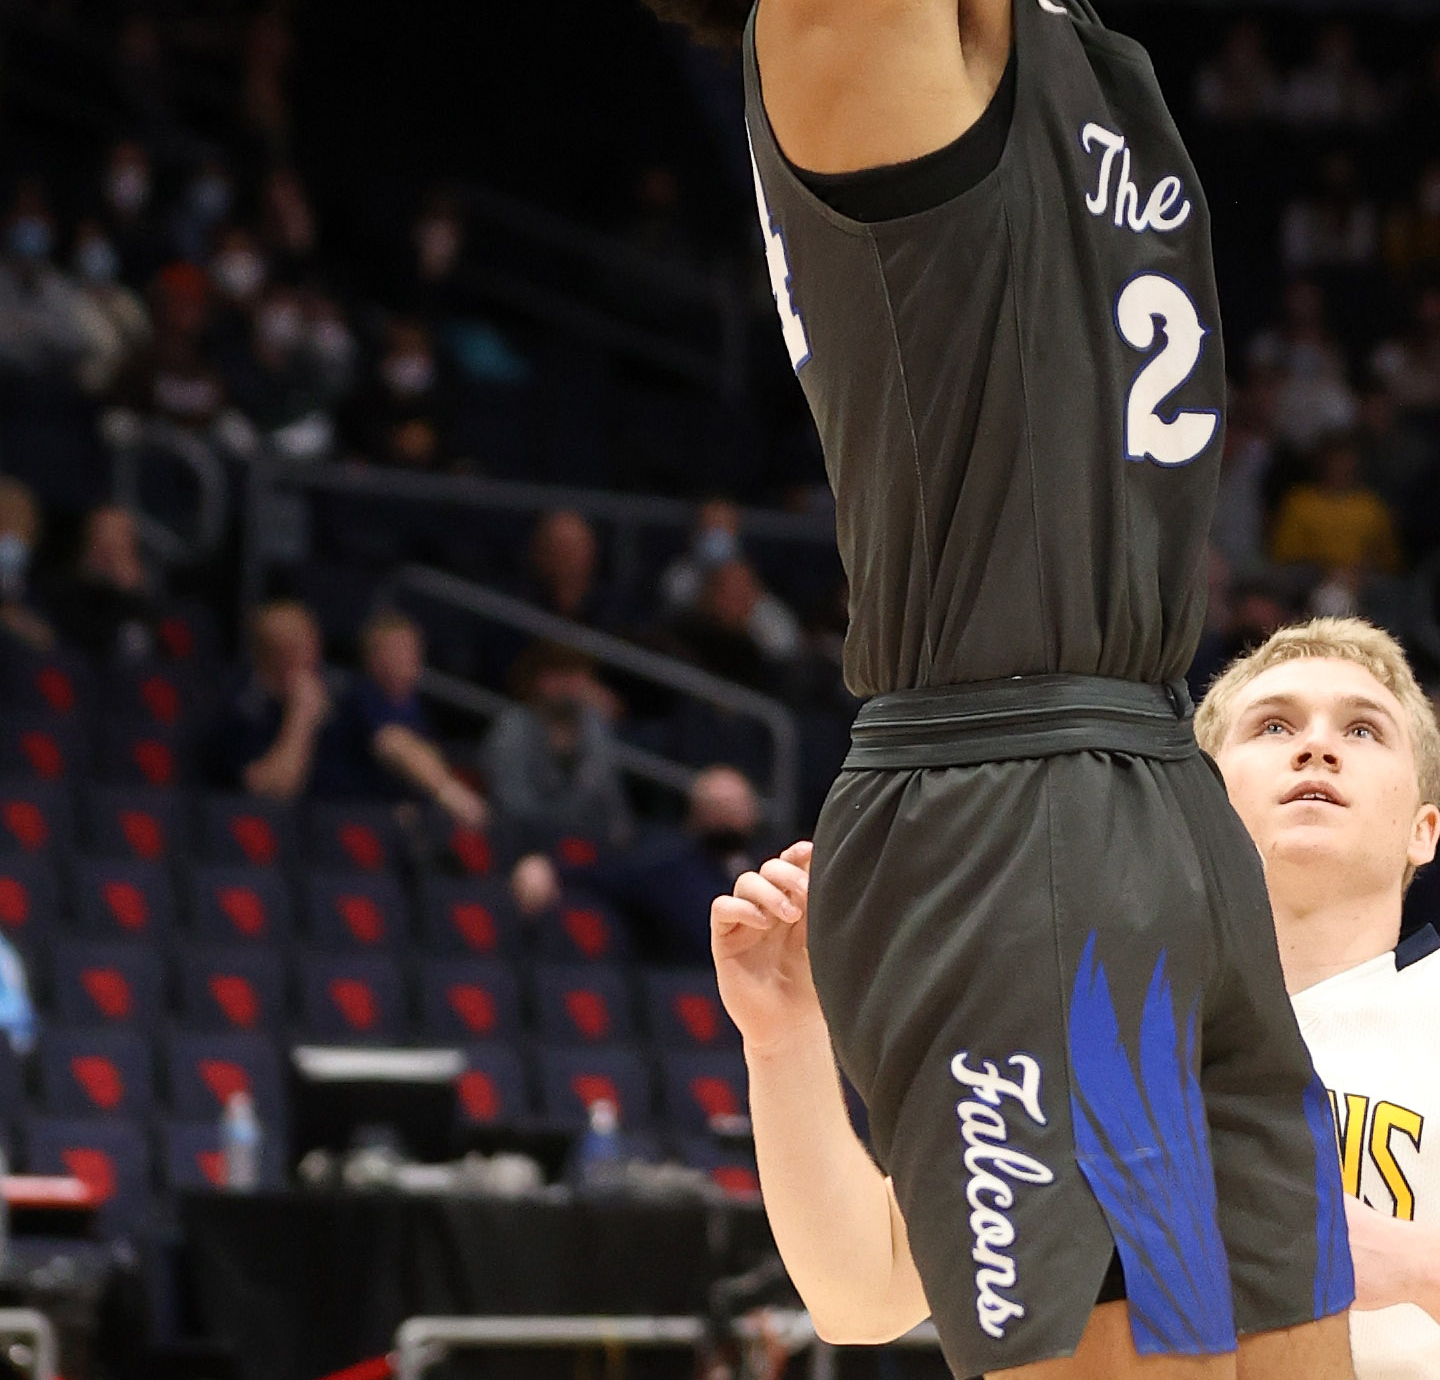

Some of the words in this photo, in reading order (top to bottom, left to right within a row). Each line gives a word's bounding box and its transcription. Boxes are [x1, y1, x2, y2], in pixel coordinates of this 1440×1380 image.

[1081, 121, 1192, 235] The
[1113, 269, 1222, 469] 2
[950, 1050, 1056, 1340] Falcons
